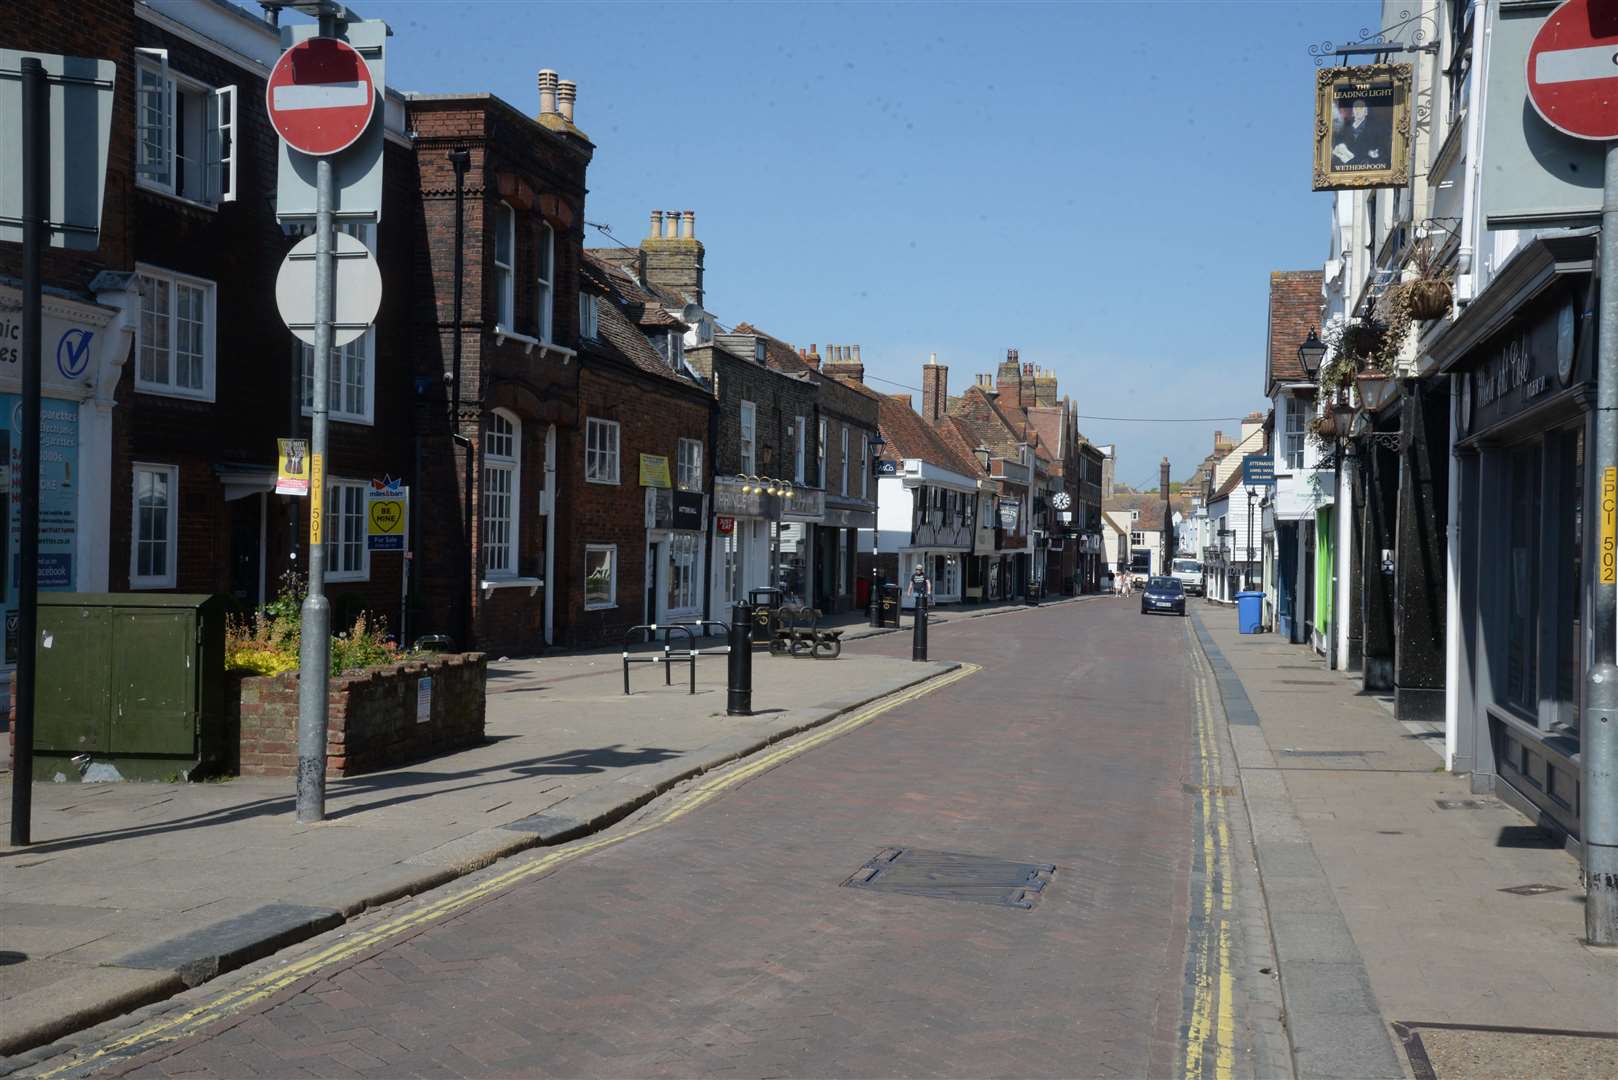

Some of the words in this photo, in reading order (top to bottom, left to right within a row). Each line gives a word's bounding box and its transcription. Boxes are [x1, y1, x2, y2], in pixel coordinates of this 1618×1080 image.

[1334, 90, 1368, 99] LEADING
[1369, 88, 1393, 97] LIGHT
[1335, 163, 1386, 171] WETHERSPOON
[381, 507, 391, 515] BE
[1603, 536, 1614, 581] 502
